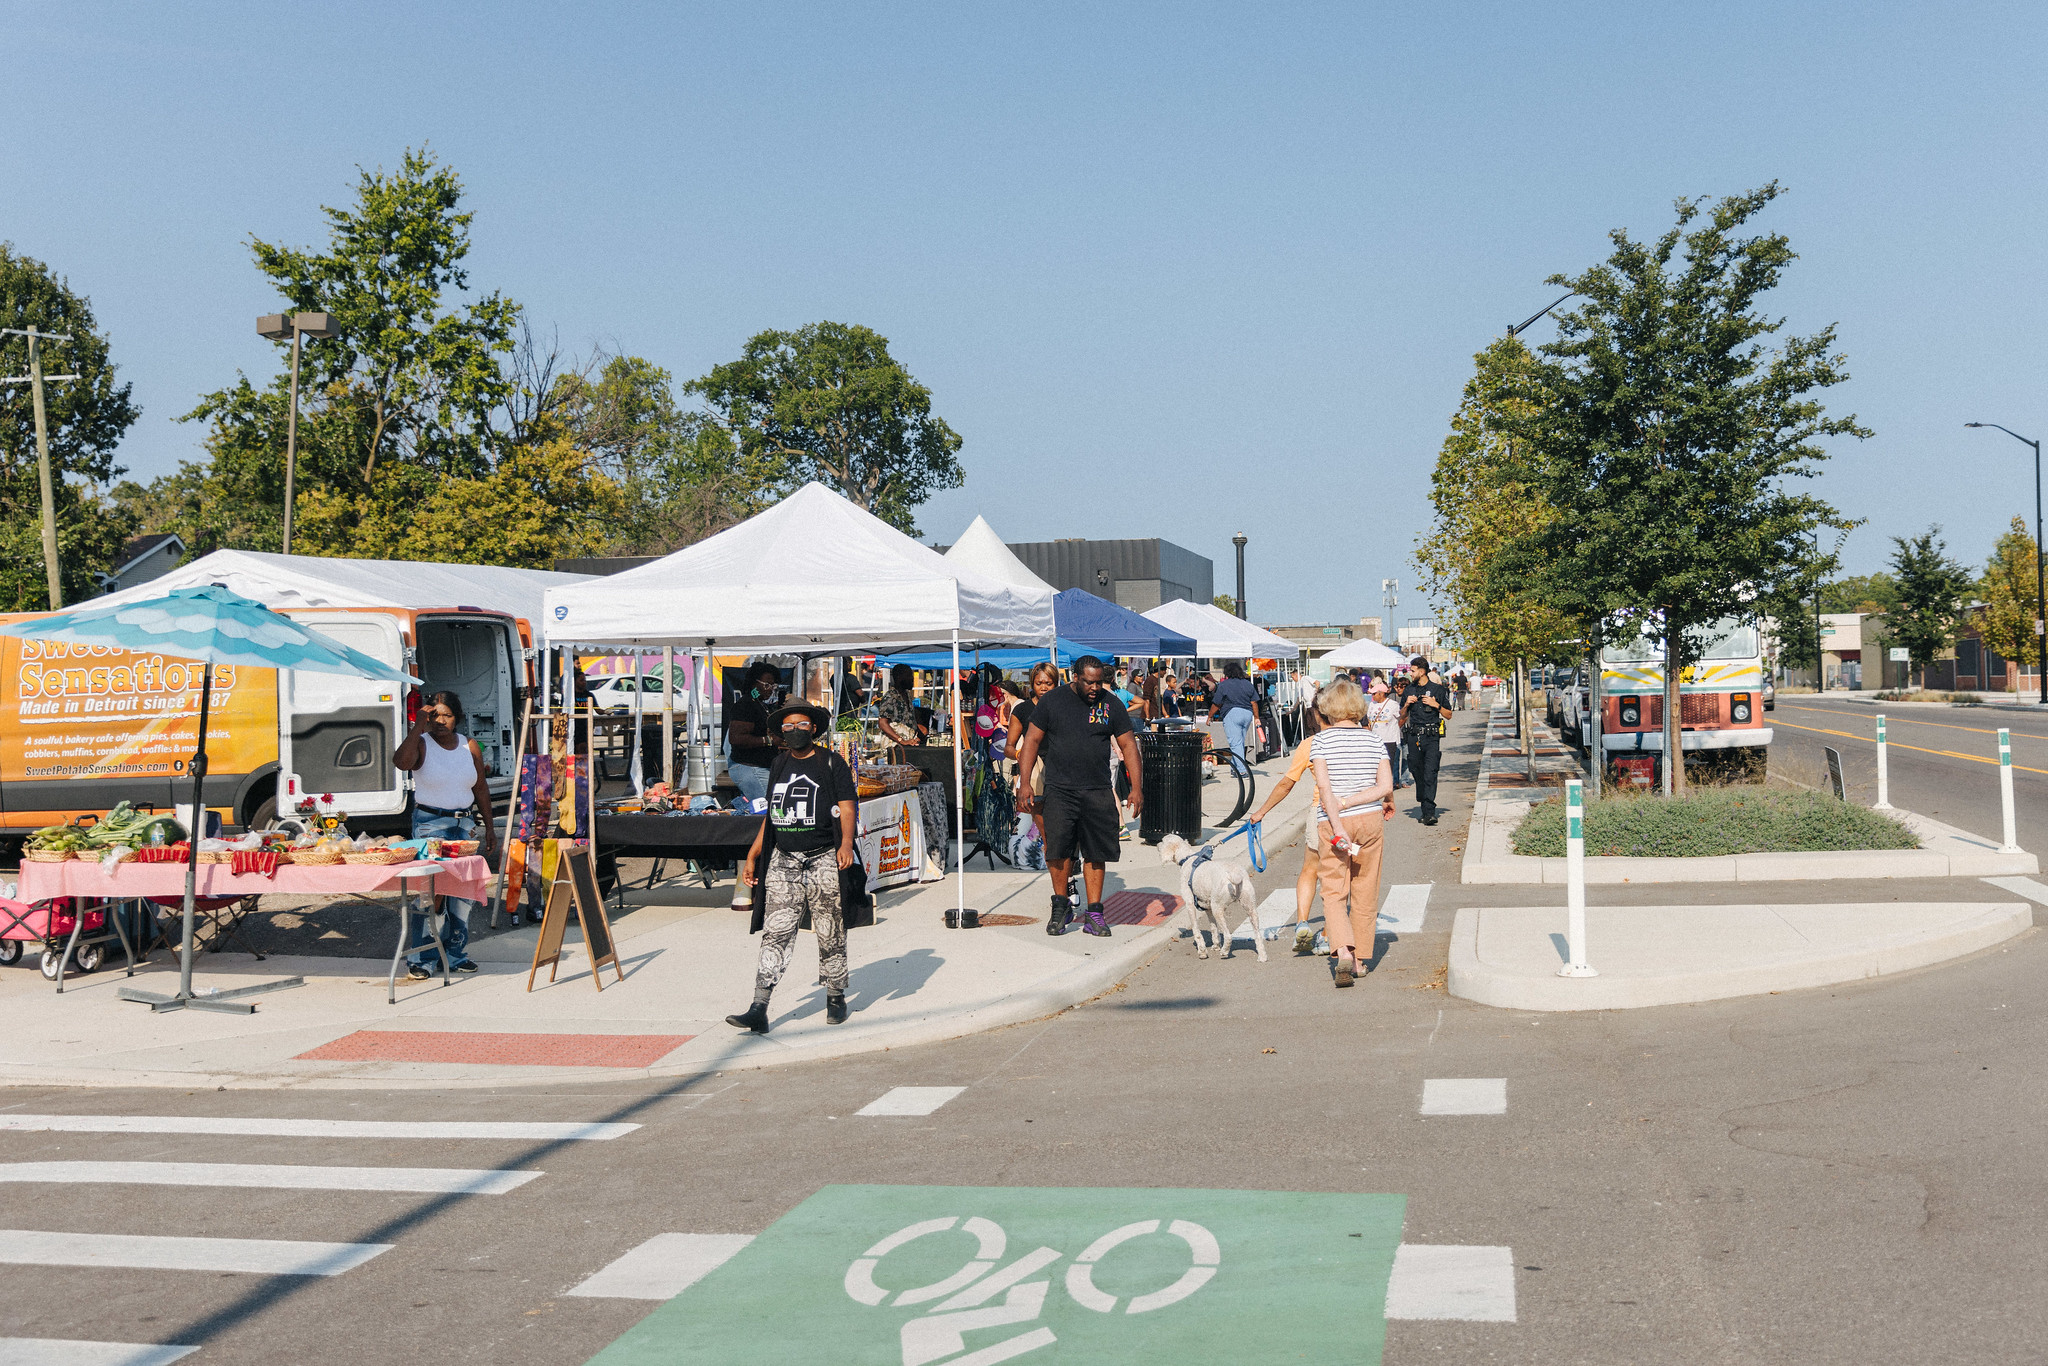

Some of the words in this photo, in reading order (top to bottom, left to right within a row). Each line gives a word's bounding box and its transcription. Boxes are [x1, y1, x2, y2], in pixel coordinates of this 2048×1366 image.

[22, 638, 124, 660] Swee
[20, 655, 236, 698] Sensations
[19, 700, 60, 715] Made
[64, 699, 79, 713] in
[84, 696, 139, 712] Detroit
[143, 696, 185, 710] since
[193, 692, 231, 708] 187
[1088, 715, 1109, 725] DAN
[24, 736, 32, 745] A
[33, 735, 64, 746] soulful,
[65, 735, 95, 745] bakery
[95, 733, 114, 743] cafe
[115, 732, 149, 743] offering
[149, 732, 169, 743] pies,
[170, 730, 196, 741] cakes,
[198, 729, 231, 739] okies,
[24, 749, 60, 758] cobblers,
[61, 747, 95, 757] muffins,
[96, 746, 140, 756] cornbread,
[142, 744, 172, 754] waffles
[173, 744, 180, 752] &
[25, 763, 168, 776] SweetPotatoSensations.com
[881, 833, 899, 848] Sweet
[880, 847, 898, 861] Potato
